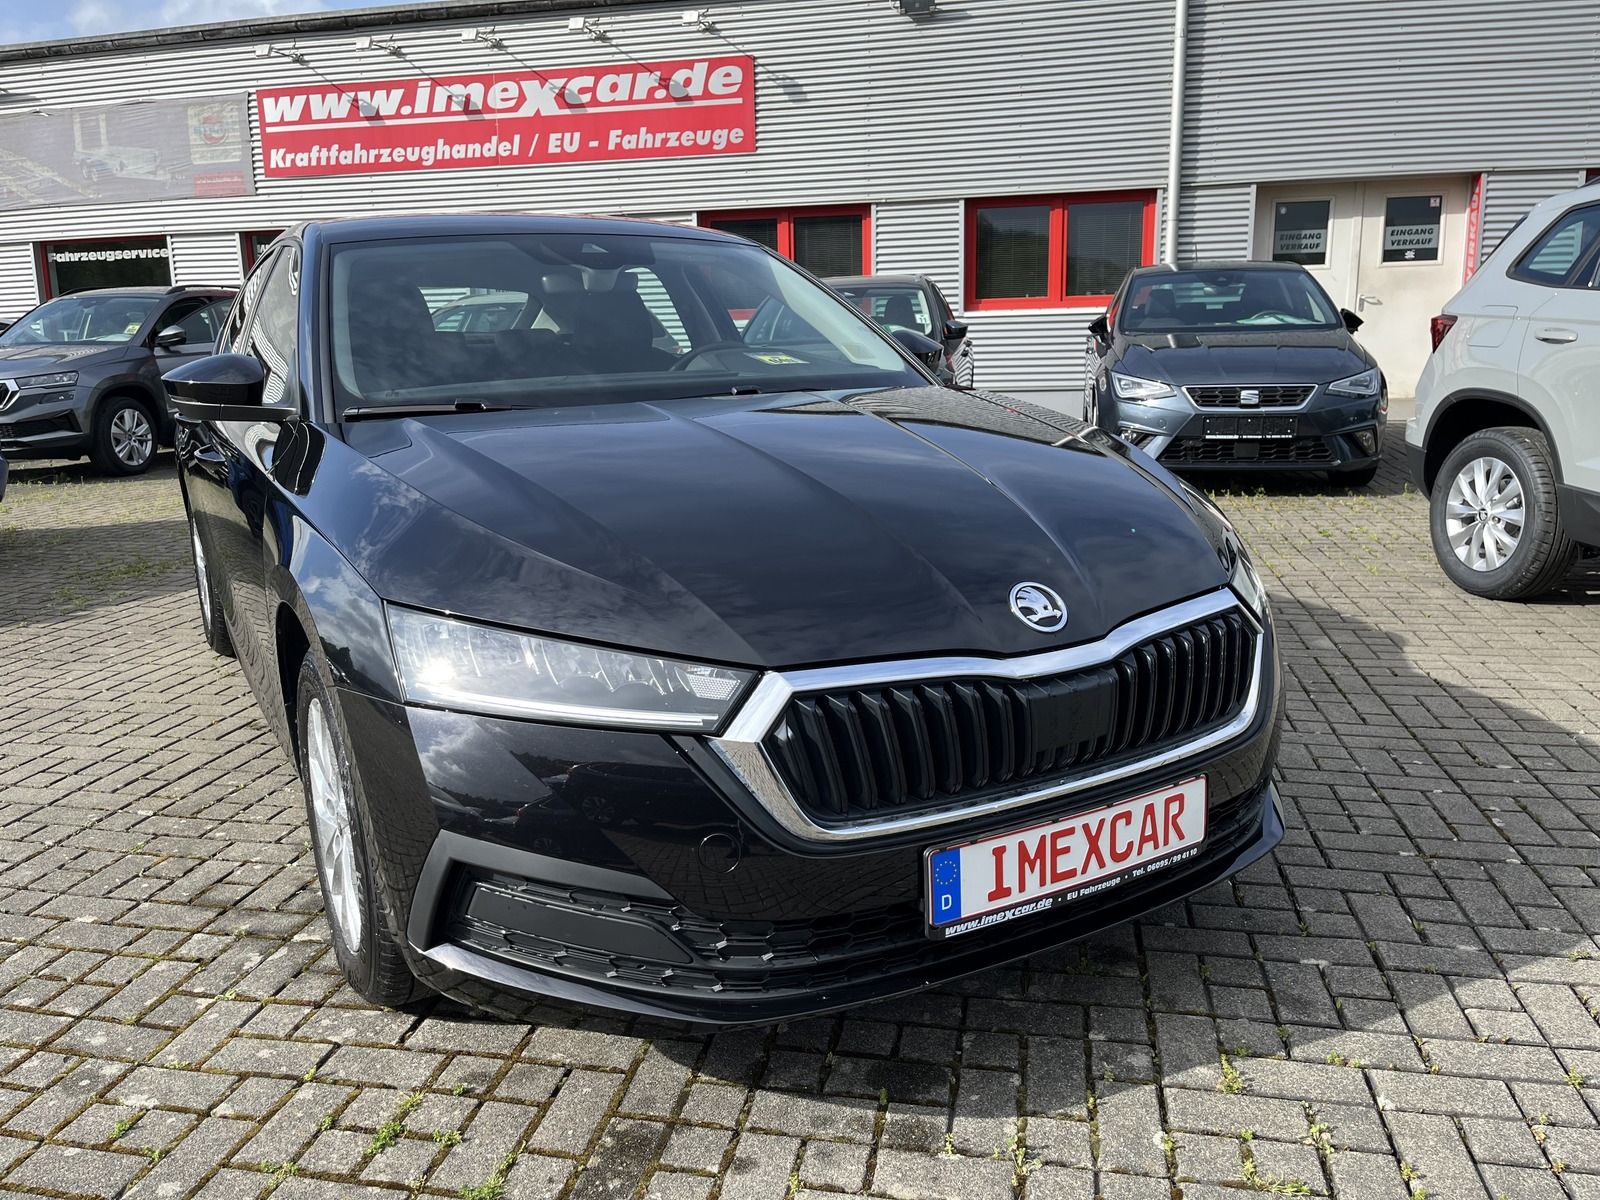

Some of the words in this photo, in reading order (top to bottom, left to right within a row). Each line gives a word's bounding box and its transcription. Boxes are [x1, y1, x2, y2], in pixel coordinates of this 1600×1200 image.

[262, 62, 743, 123] www.imexcar.de
[270, 134, 519, 169] Kraftfahrzeughandel
[548, 132, 581, 153] EU
[608, 127, 744, 151] Fahrzeuge
[1280, 232, 1322, 241] EINGANG
[1390, 228, 1434, 237] EINGANG
[1280, 242, 1321, 250] VERKAUF
[1390, 238, 1433, 247] VERKAUF
[48, 248, 169, 262] Fahrzeugservice
[987, 792, 1185, 902] IMEXCAR
[941, 894, 952, 911] D
[945, 898, 1053, 936] www.imexcar.de
[1067, 890, 1078, 900] EU
[1079, 876, 1121, 896] Fahrzeuge
[1132, 867, 1145, 877] Tel.
